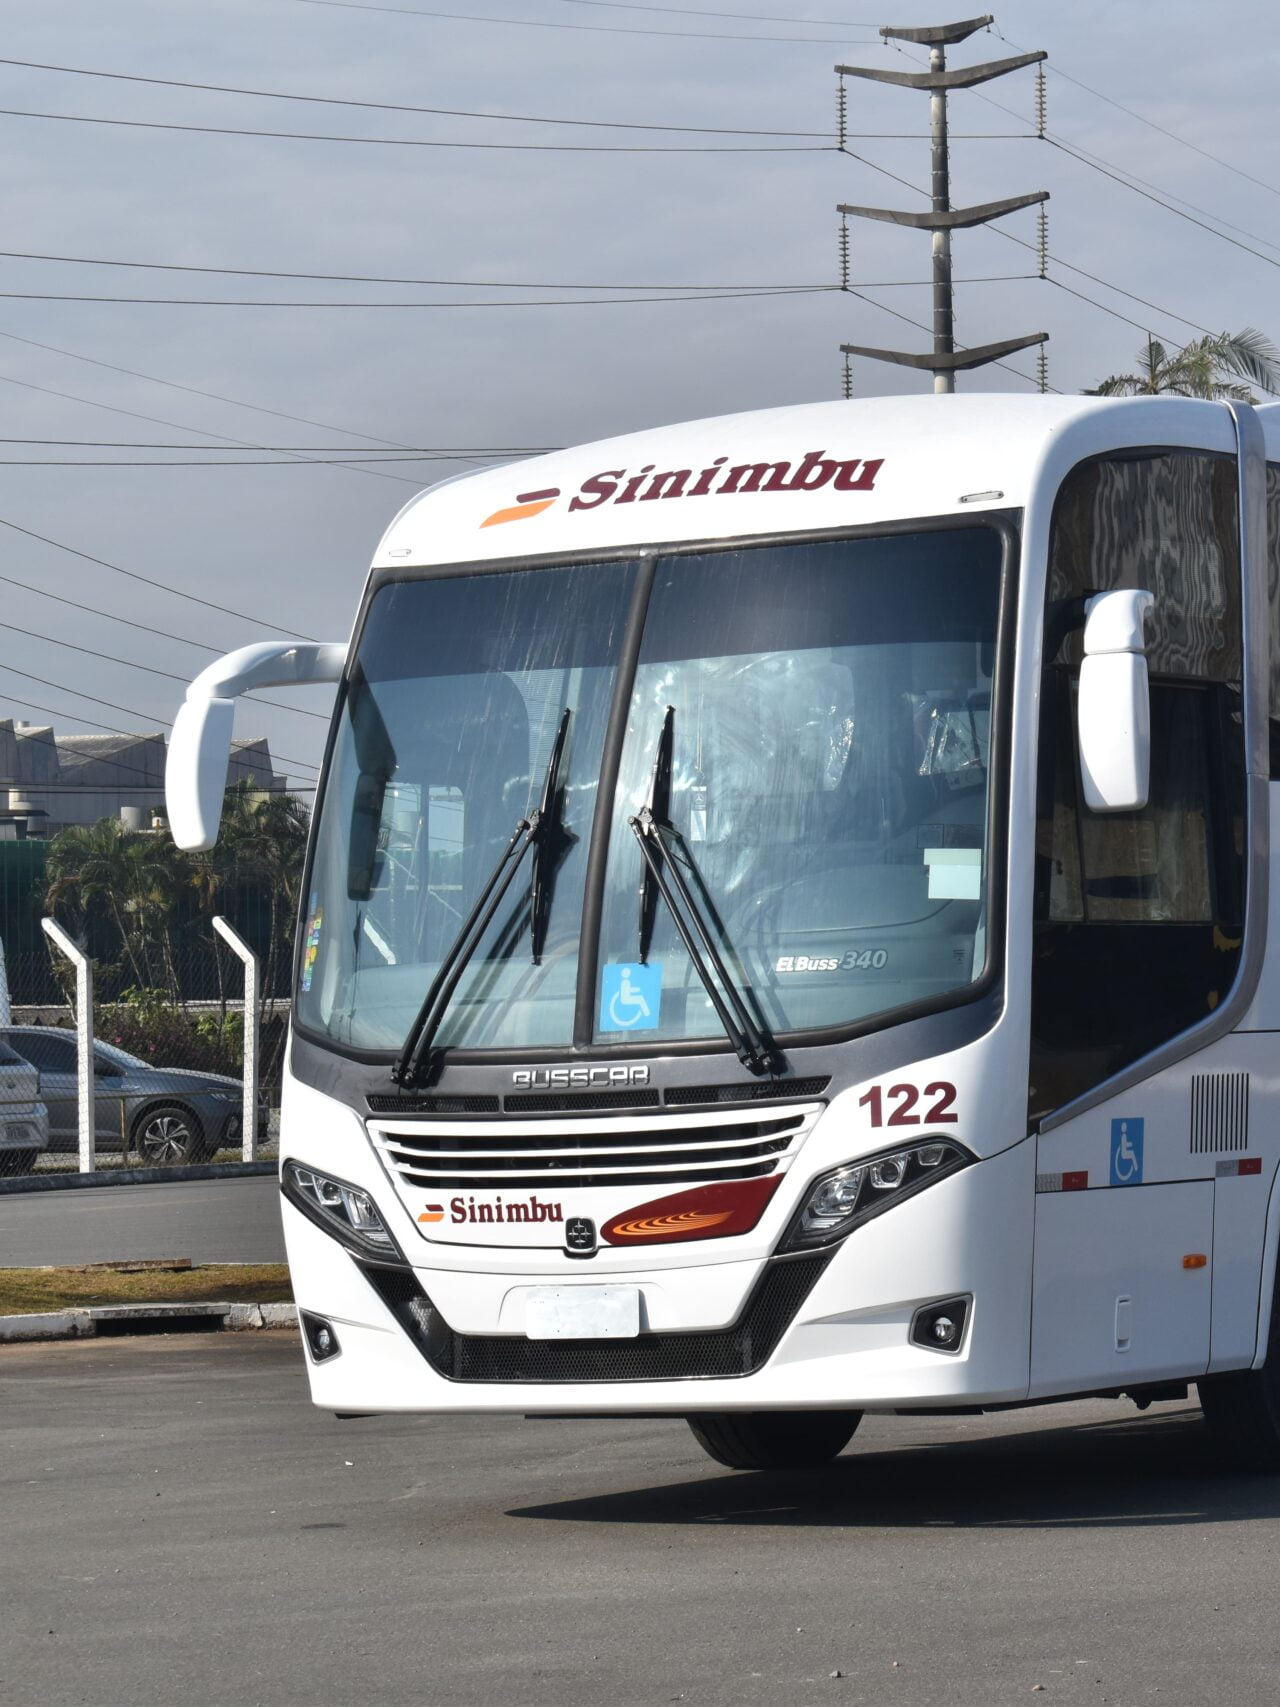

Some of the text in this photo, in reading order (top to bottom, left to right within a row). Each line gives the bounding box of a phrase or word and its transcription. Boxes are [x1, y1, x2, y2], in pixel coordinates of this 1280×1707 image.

[568, 450, 885, 512] Sinimbu
[842, 949, 888, 970] 340
[513, 1065, 651, 1090] BUSSCAR
[859, 1081, 959, 1127] 122
[450, 1196, 563, 1224] Sinimbu
